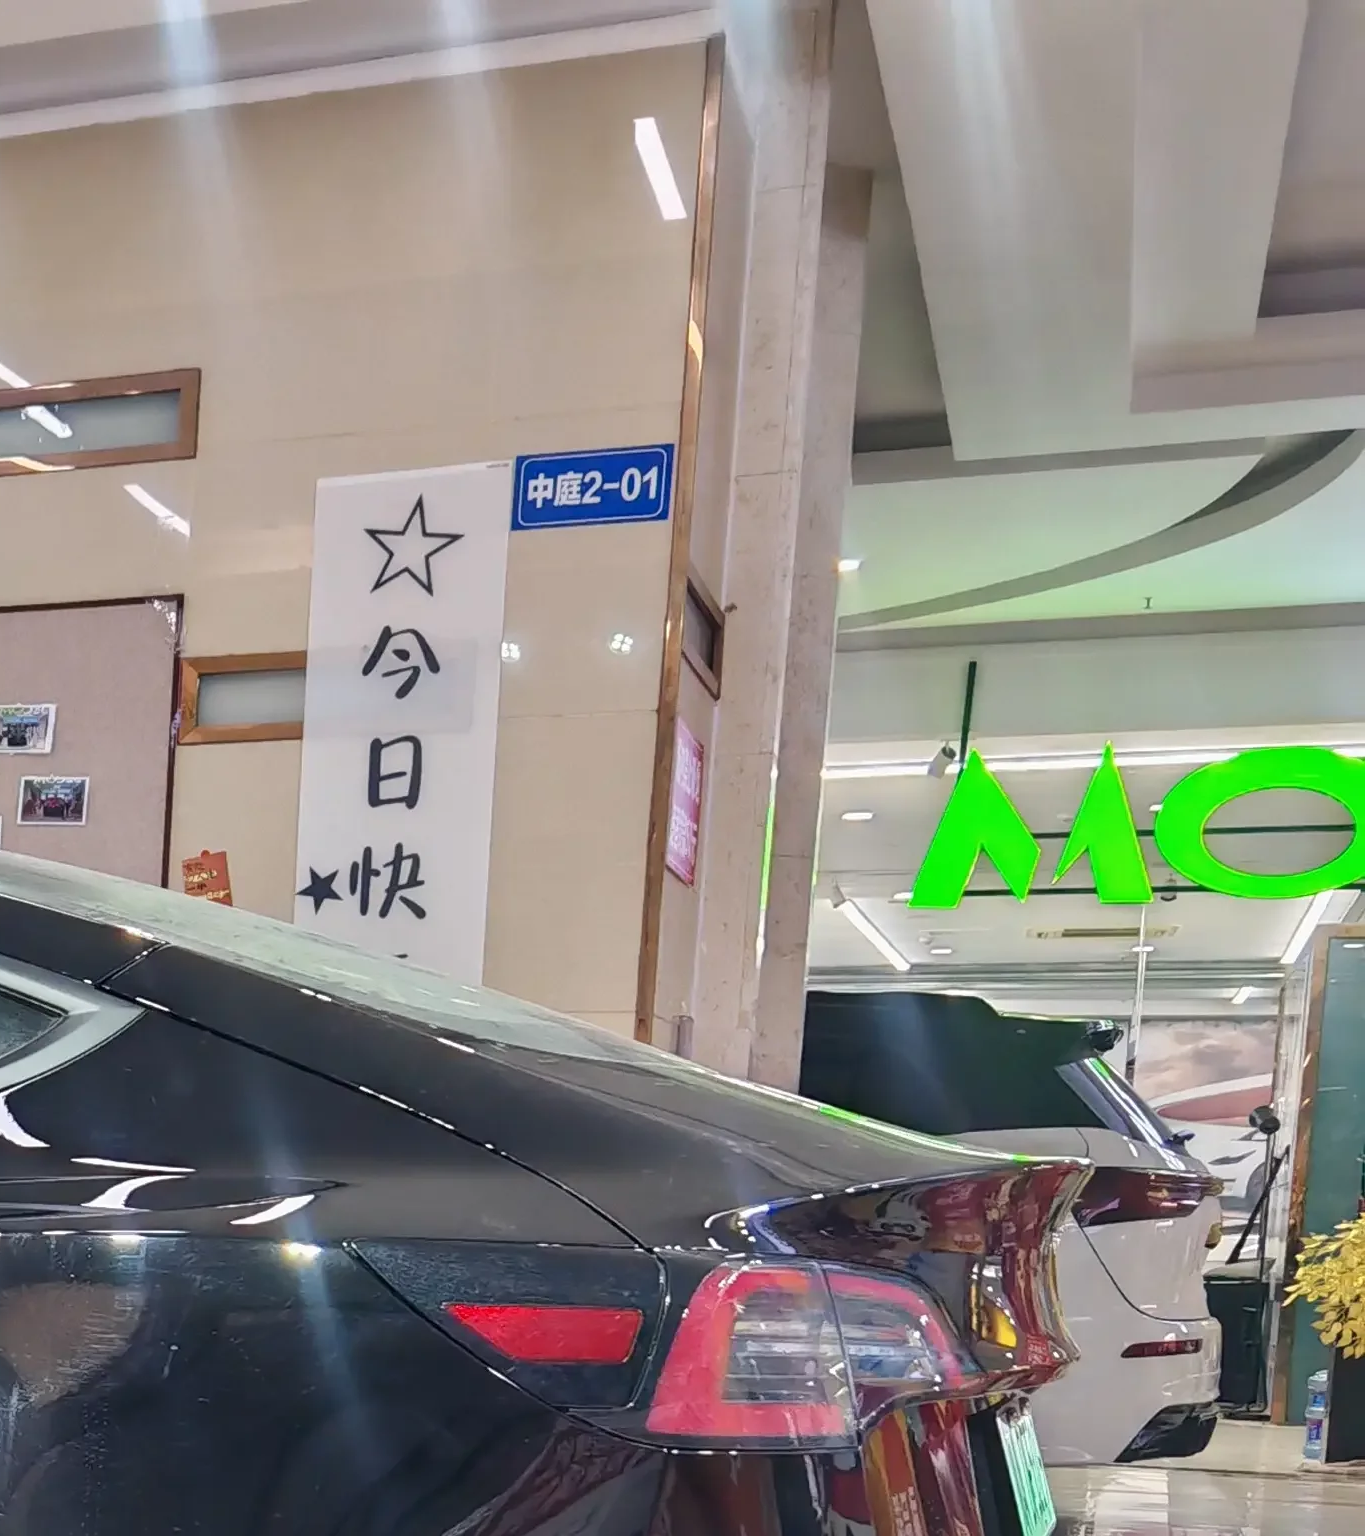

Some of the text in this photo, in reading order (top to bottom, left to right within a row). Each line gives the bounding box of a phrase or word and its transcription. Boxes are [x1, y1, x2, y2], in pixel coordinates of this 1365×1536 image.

[527, 465, 659, 509] 中庭2-01
[349, 625, 441, 959] 今日快
